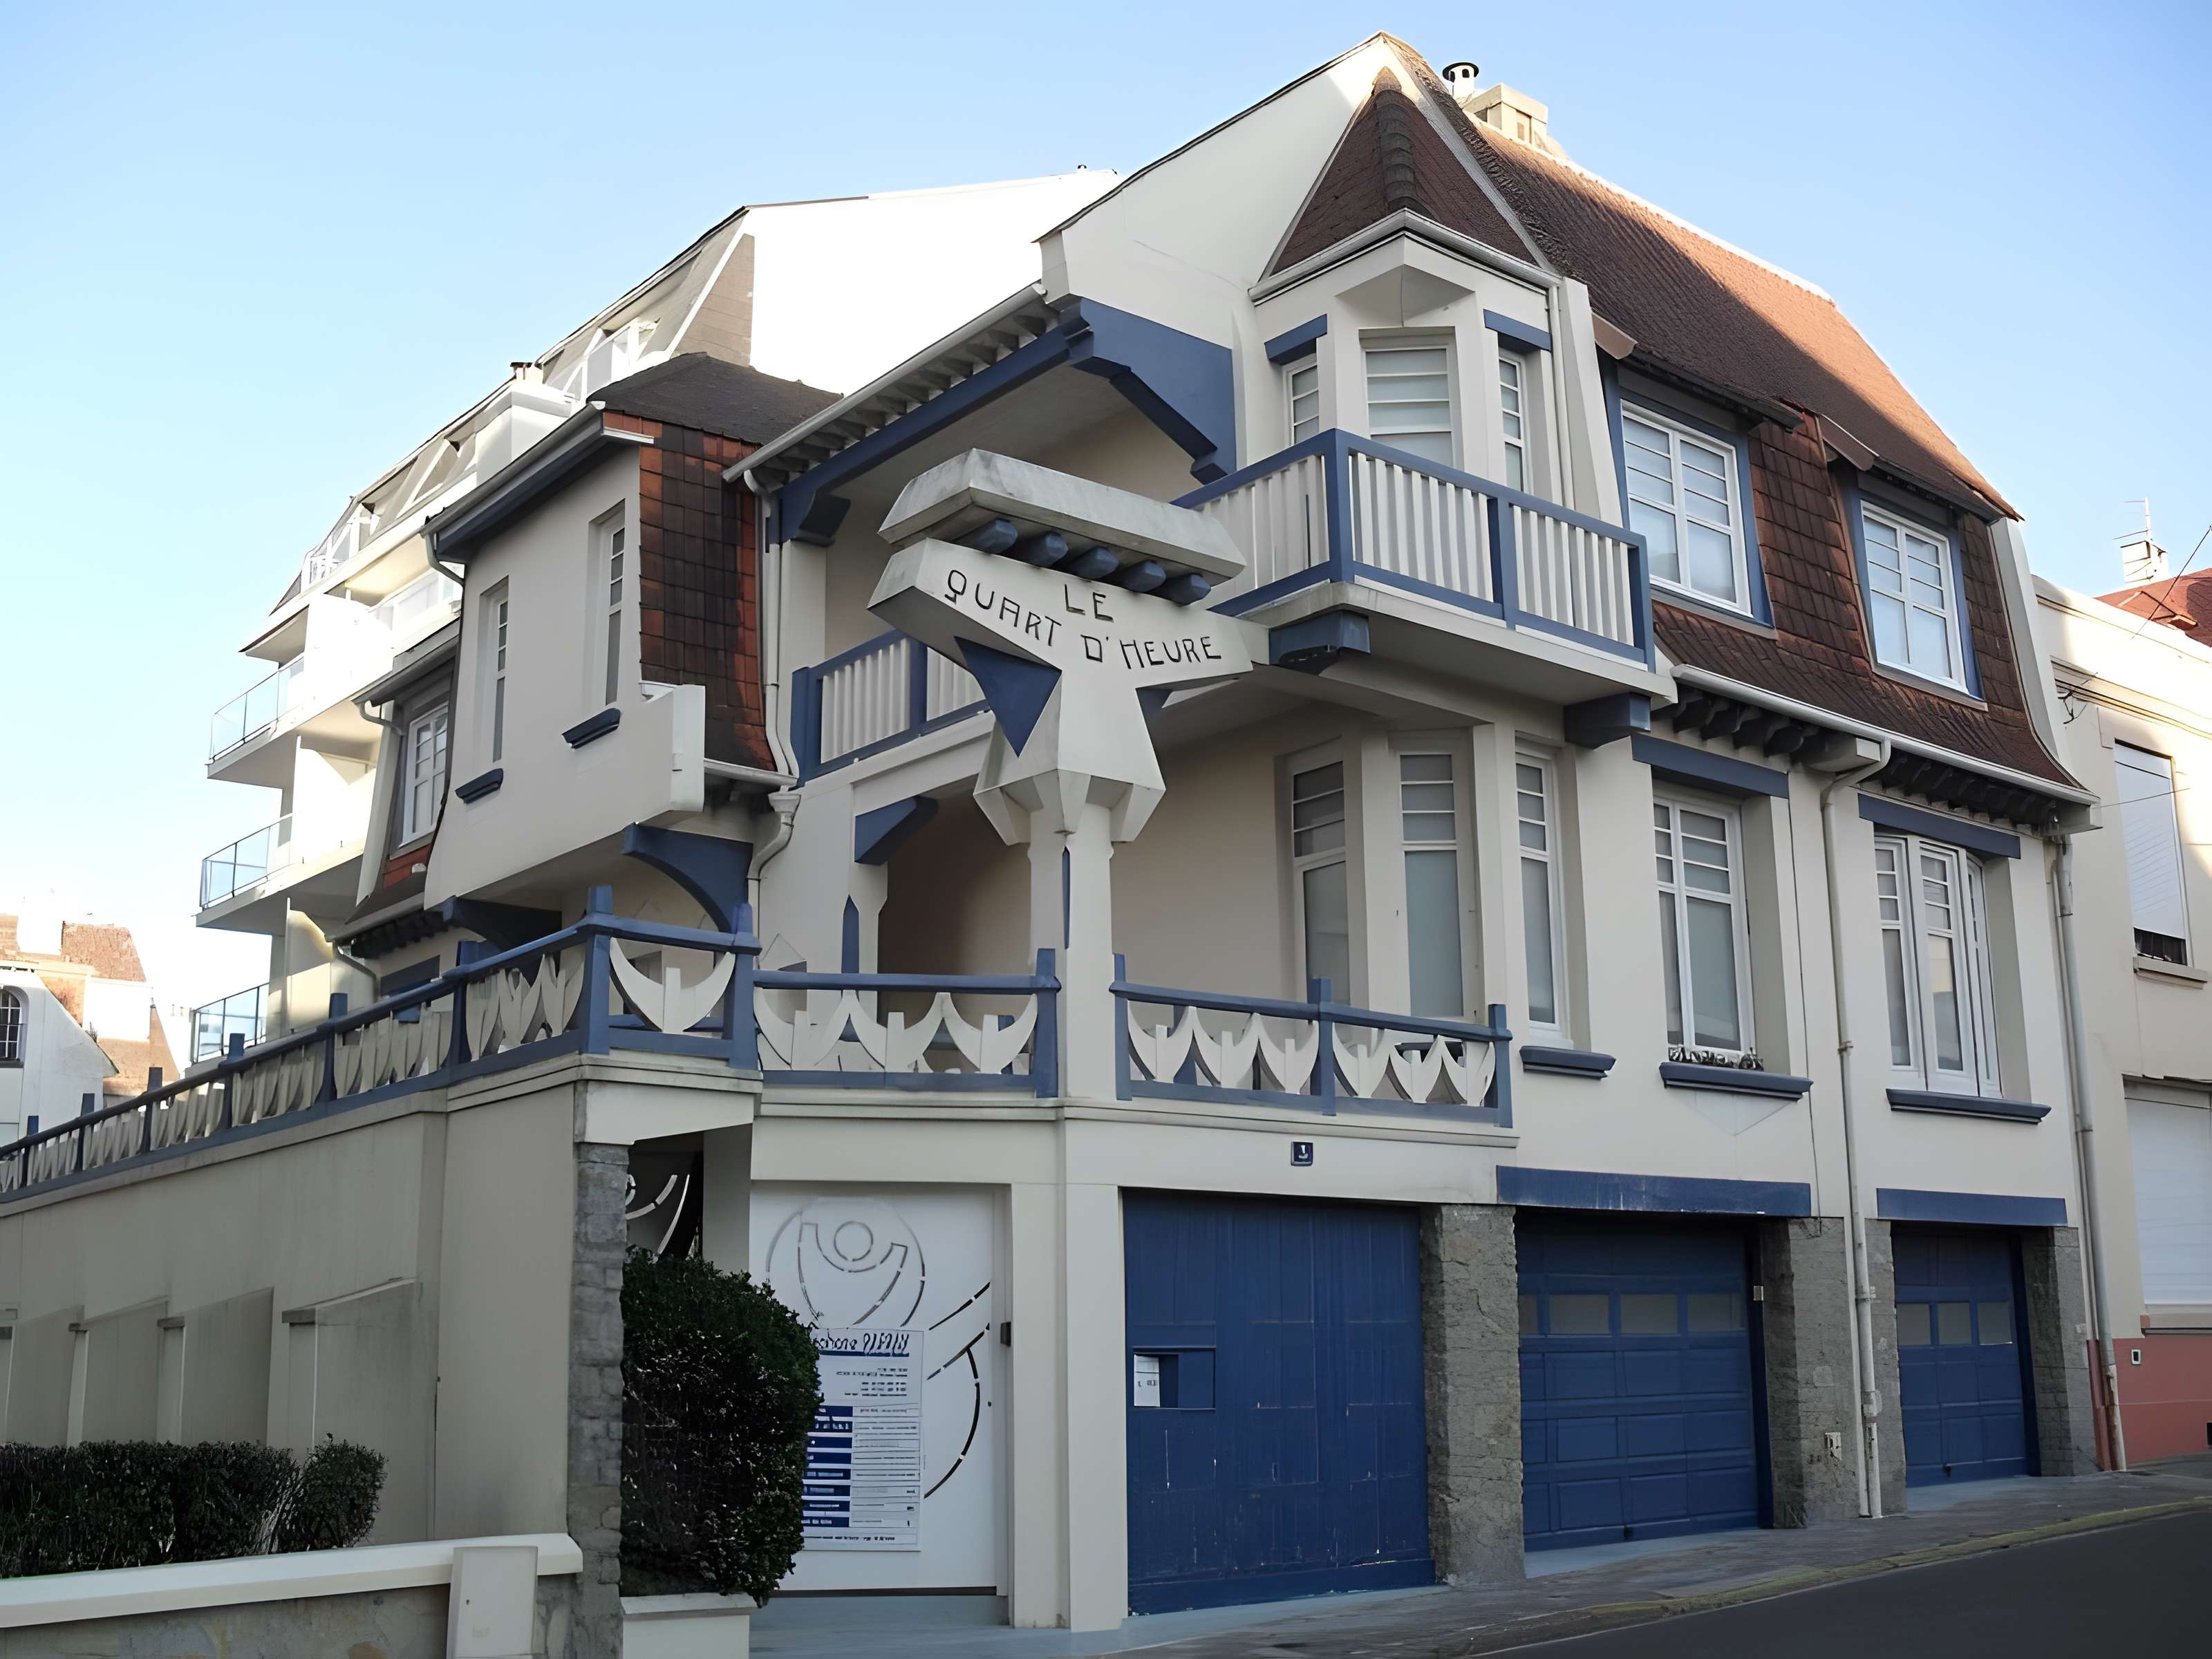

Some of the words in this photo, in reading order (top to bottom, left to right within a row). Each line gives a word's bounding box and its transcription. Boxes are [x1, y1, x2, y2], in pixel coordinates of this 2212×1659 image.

[944, 570, 1062, 647] QUART
[1080, 634, 1222, 670] D'HEURE
[1064, 583, 1114, 622] LE
